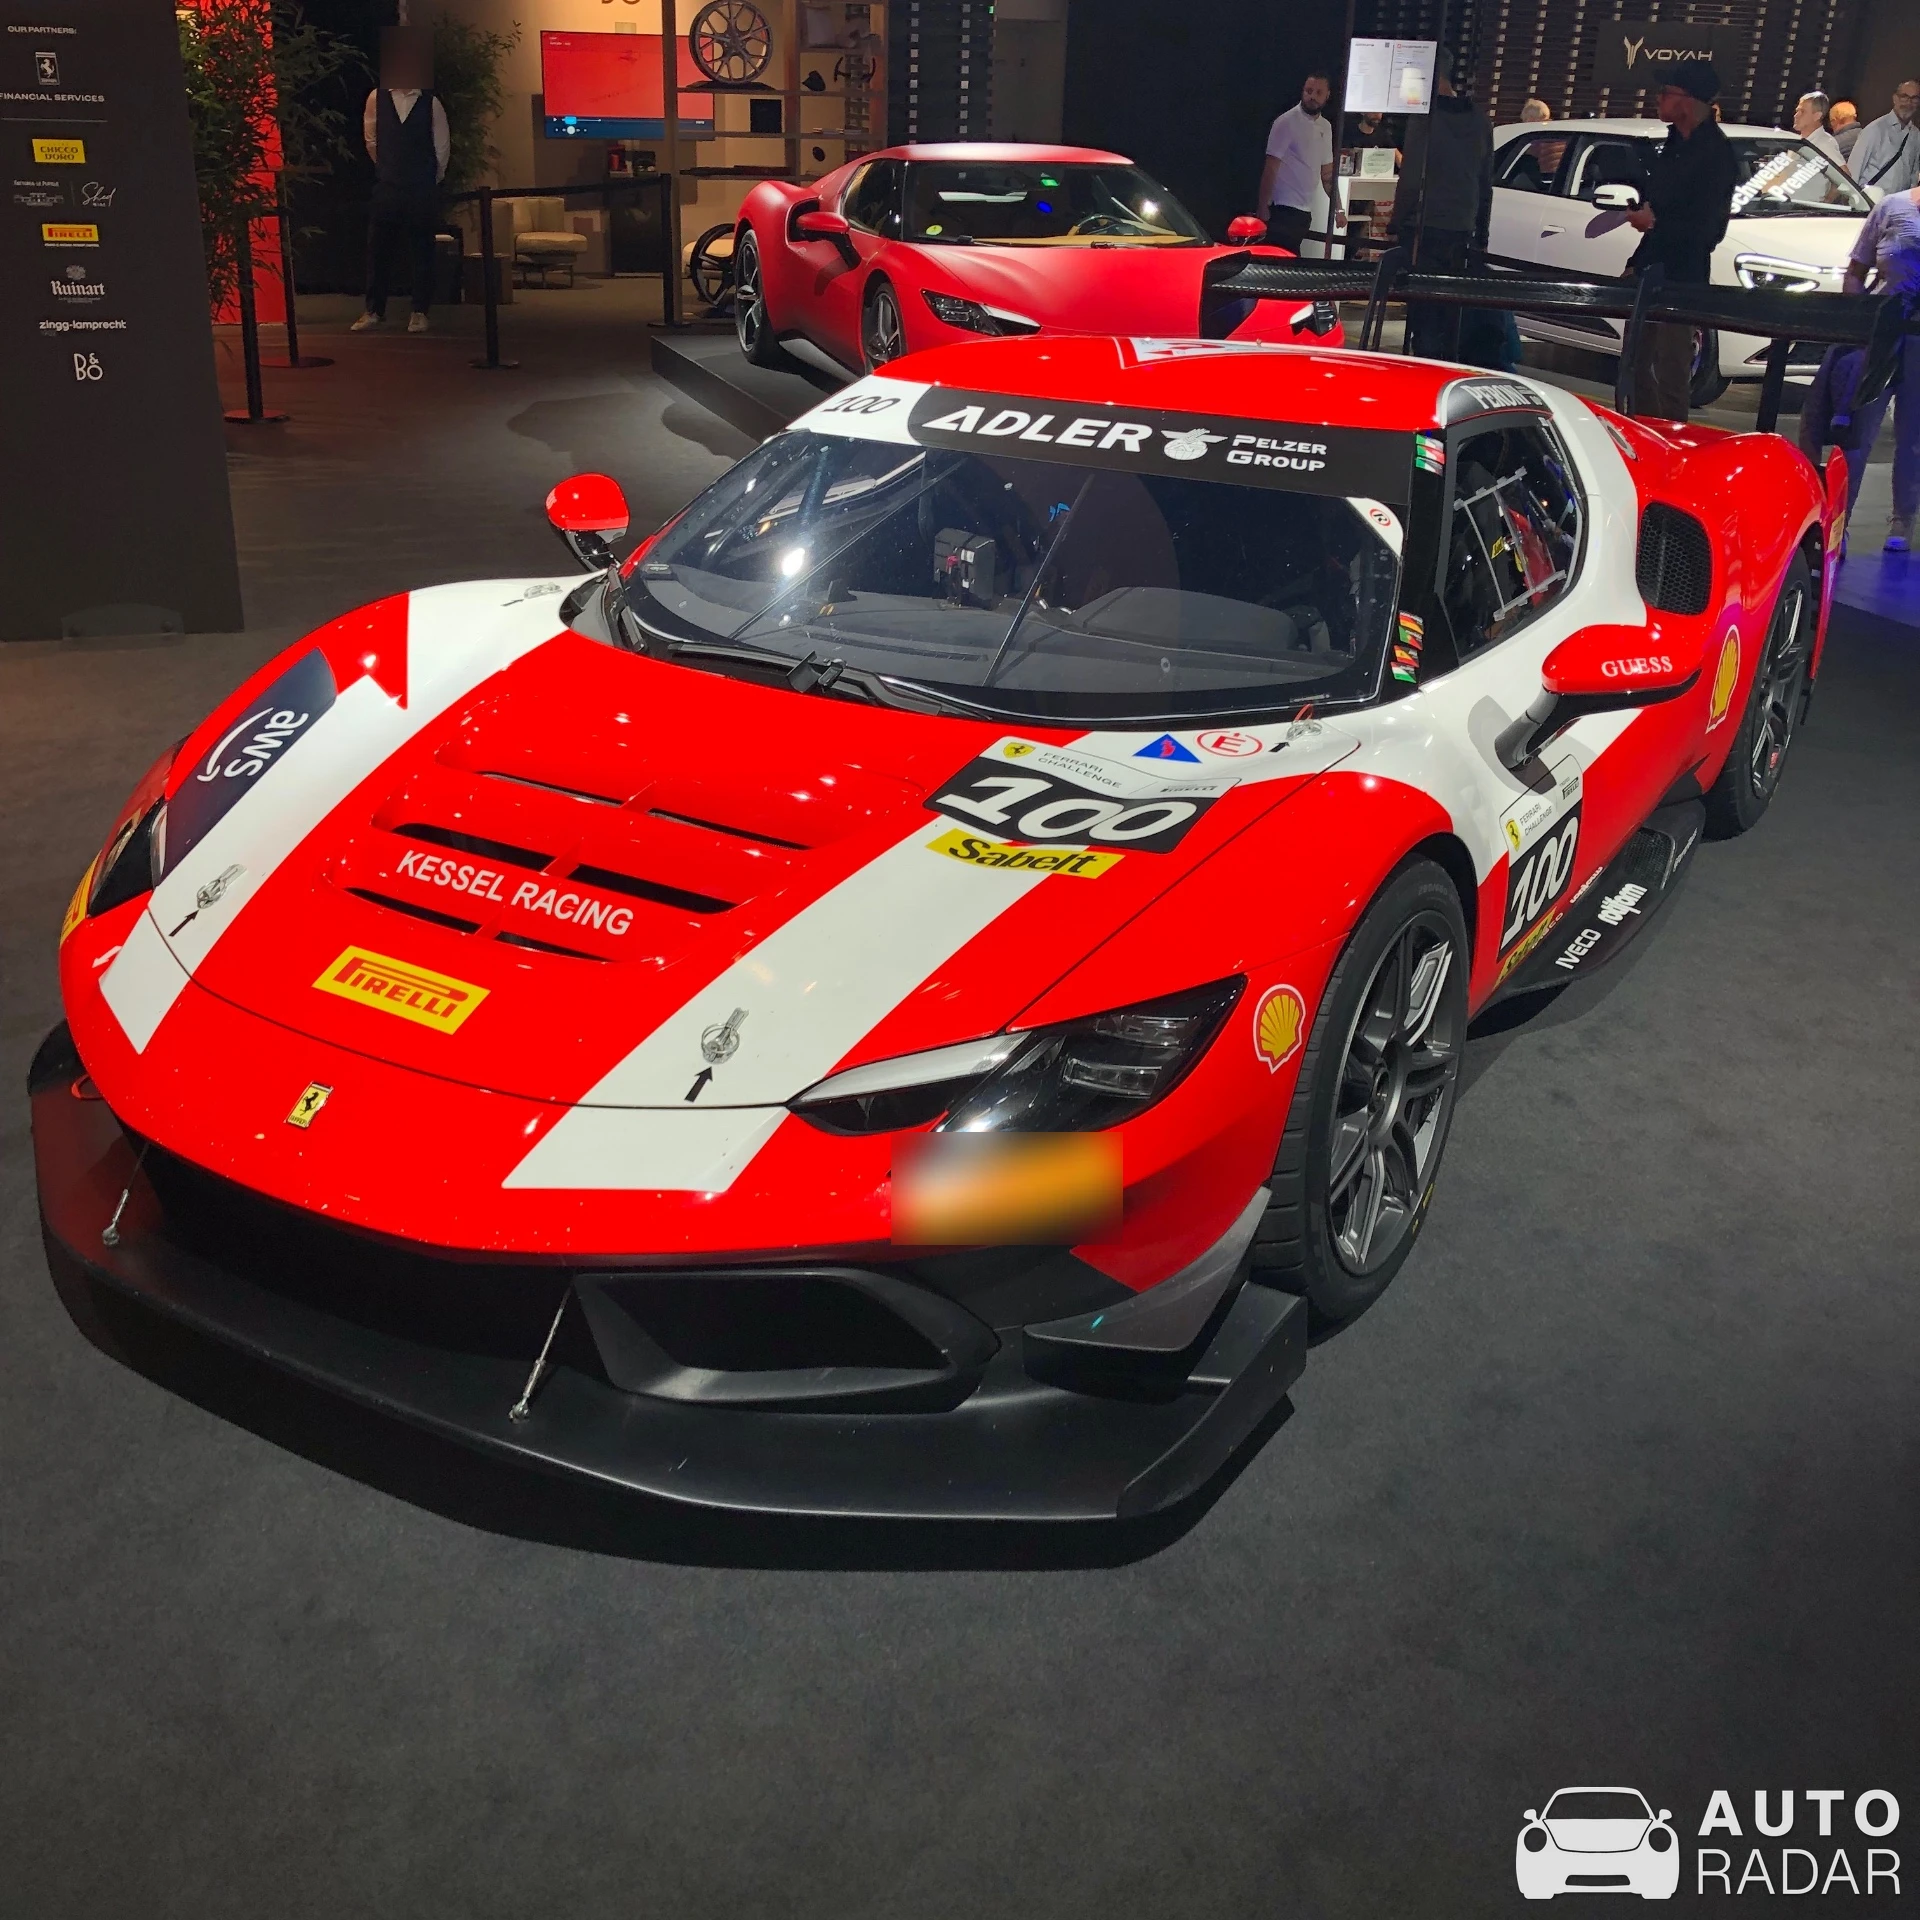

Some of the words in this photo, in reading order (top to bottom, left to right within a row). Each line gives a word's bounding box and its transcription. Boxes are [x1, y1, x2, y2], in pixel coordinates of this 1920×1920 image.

[7, 25, 28, 33] OUR
[28, 26, 77, 34] PARTNERS:
[1644, 48, 1713, 62] VOYAH
[0, 92, 52, 101] FINANCIAL
[54, 94, 105, 102] SERVICES
[40, 146, 79, 154] CHICCO
[47, 227, 93, 238] PIRELLI
[50, 280, 106, 296] Ruinart
[39, 320, 127, 331] zingg-lamprecht
[820, 395, 902, 415] 100
[1460, 384, 1532, 410] PERONI
[921, 404, 1154, 453] ADLER
[1231, 433, 1328, 456] PELZER
[1225, 450, 1327, 473] GROUP
[1600, 655, 1674, 678] GUESS
[223, 709, 310, 778] aws
[1037, 757, 1123, 789] CHALLENGE
[1043, 752, 1104, 774] FERRARI
[935, 776, 1198, 841] 100
[1519, 802, 1542, 827] FERRARI
[1524, 805, 1553, 837] CHALLENGE
[948, 838, 1098, 874] Sabelt
[396, 849, 504, 902] KESSEL
[510, 881, 634, 936] RACING
[1500, 816, 1579, 951] 100
[1554, 928, 1602, 970] IVECO
[331, 956, 470, 1019] PIRELLI
